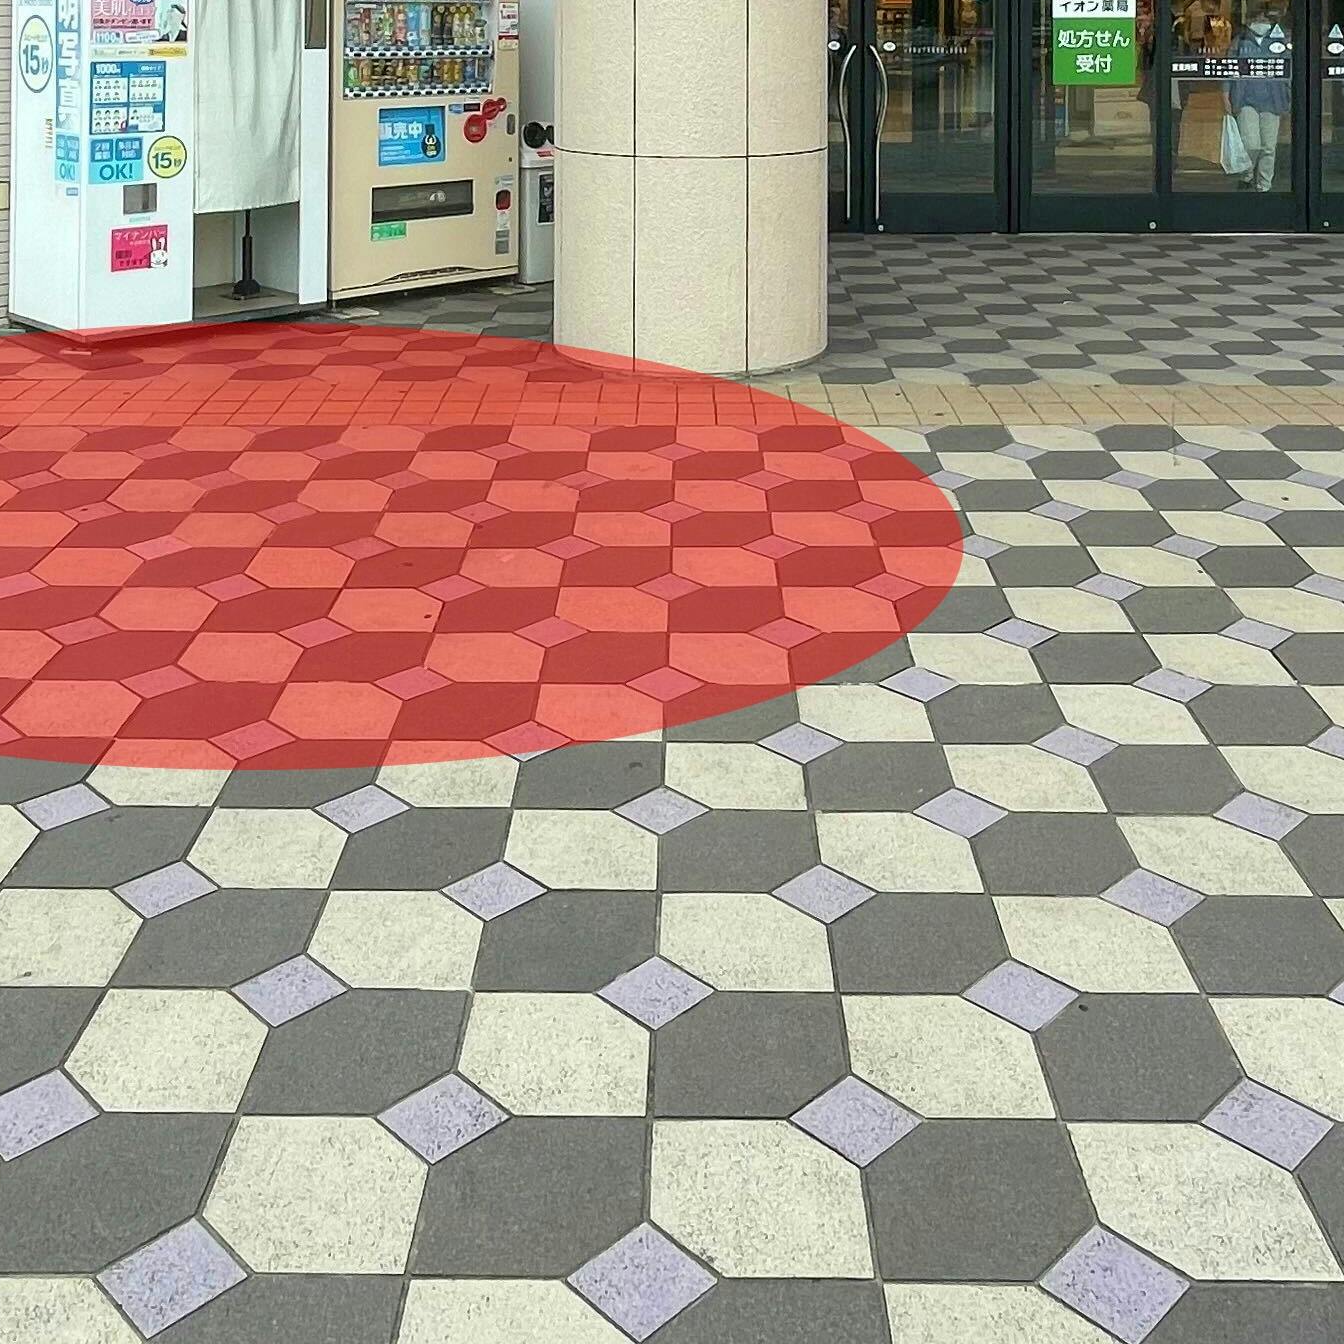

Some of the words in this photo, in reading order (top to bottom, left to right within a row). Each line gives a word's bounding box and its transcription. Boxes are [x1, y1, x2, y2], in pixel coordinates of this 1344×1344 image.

[1059, 0, 1129, 13] イオン薬局
[1058, 29, 1130, 48] 処方せん
[1075, 54, 1113, 74] 受付
[99, 162, 133, 181] OK!
